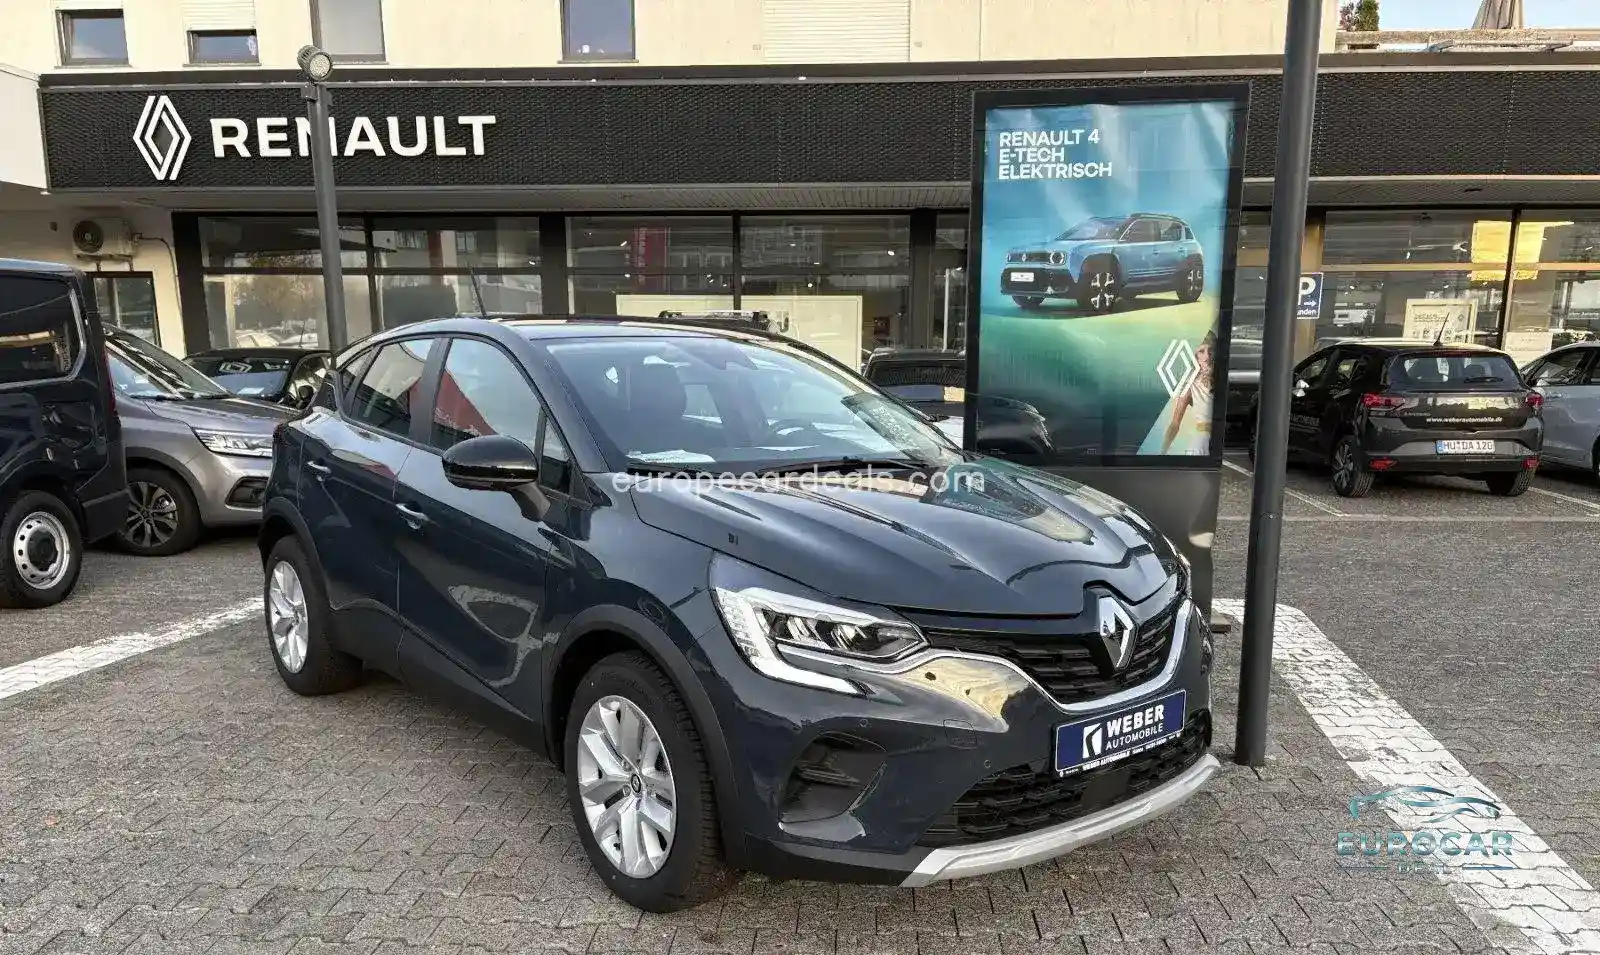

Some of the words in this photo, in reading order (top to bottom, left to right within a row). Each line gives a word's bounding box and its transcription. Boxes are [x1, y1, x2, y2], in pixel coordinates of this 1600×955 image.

[210, 115, 497, 158] RENAULT
[1000, 130, 1085, 147] RENAULT
[1087, 128, 1101, 145] 4
[1000, 147, 1065, 163] E-TECH
[999, 162, 1113, 180] ELEKTRISCH
[1298, 276, 1316, 305] P
[1106, 704, 1165, 738] WEBER
[1105, 722, 1164, 751] AUTOMOBILE
